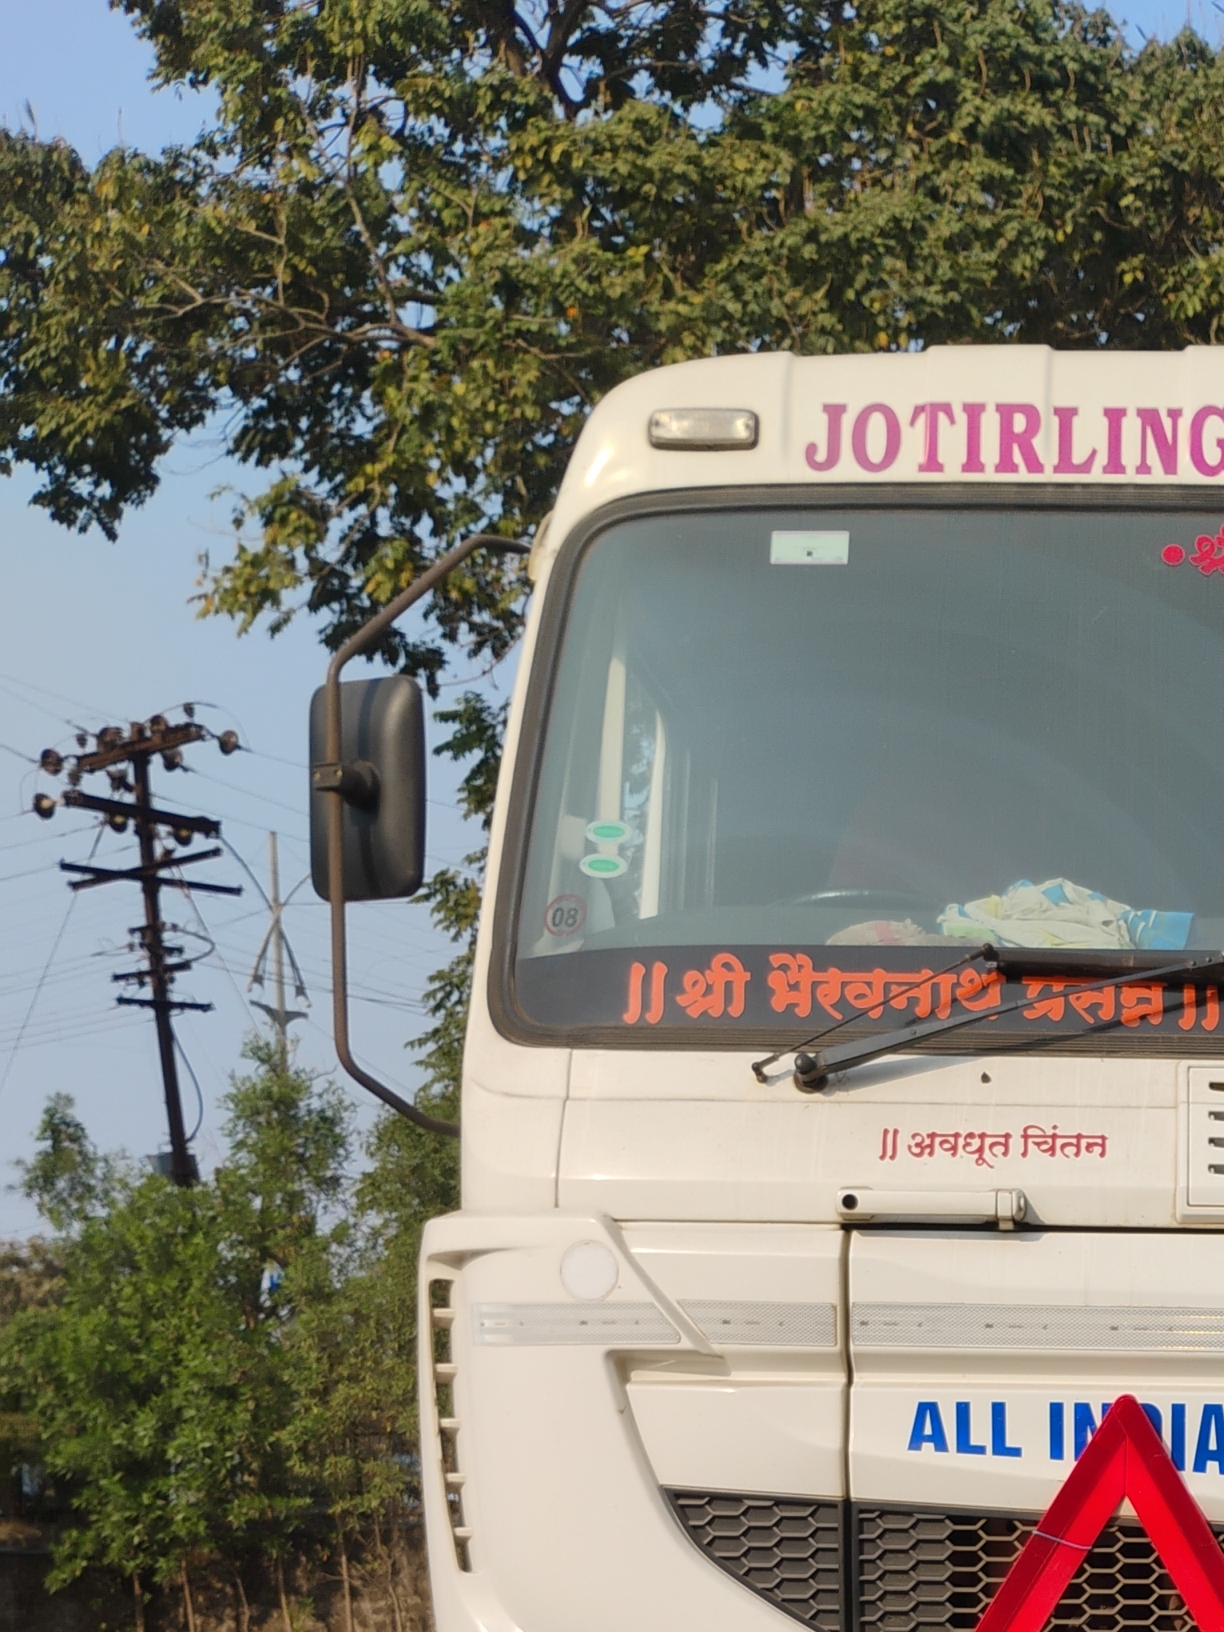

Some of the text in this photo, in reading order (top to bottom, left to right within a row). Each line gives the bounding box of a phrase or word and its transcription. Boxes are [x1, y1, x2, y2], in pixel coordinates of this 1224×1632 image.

[552, 907, 579, 928] 08
[675, 952, 751, 1020] श्री
[907, 1131, 1013, 1169] अवधूत
[1020, 1124, 1110, 1159] चिंतन
[907, 1401, 1023, 1458] ALL
